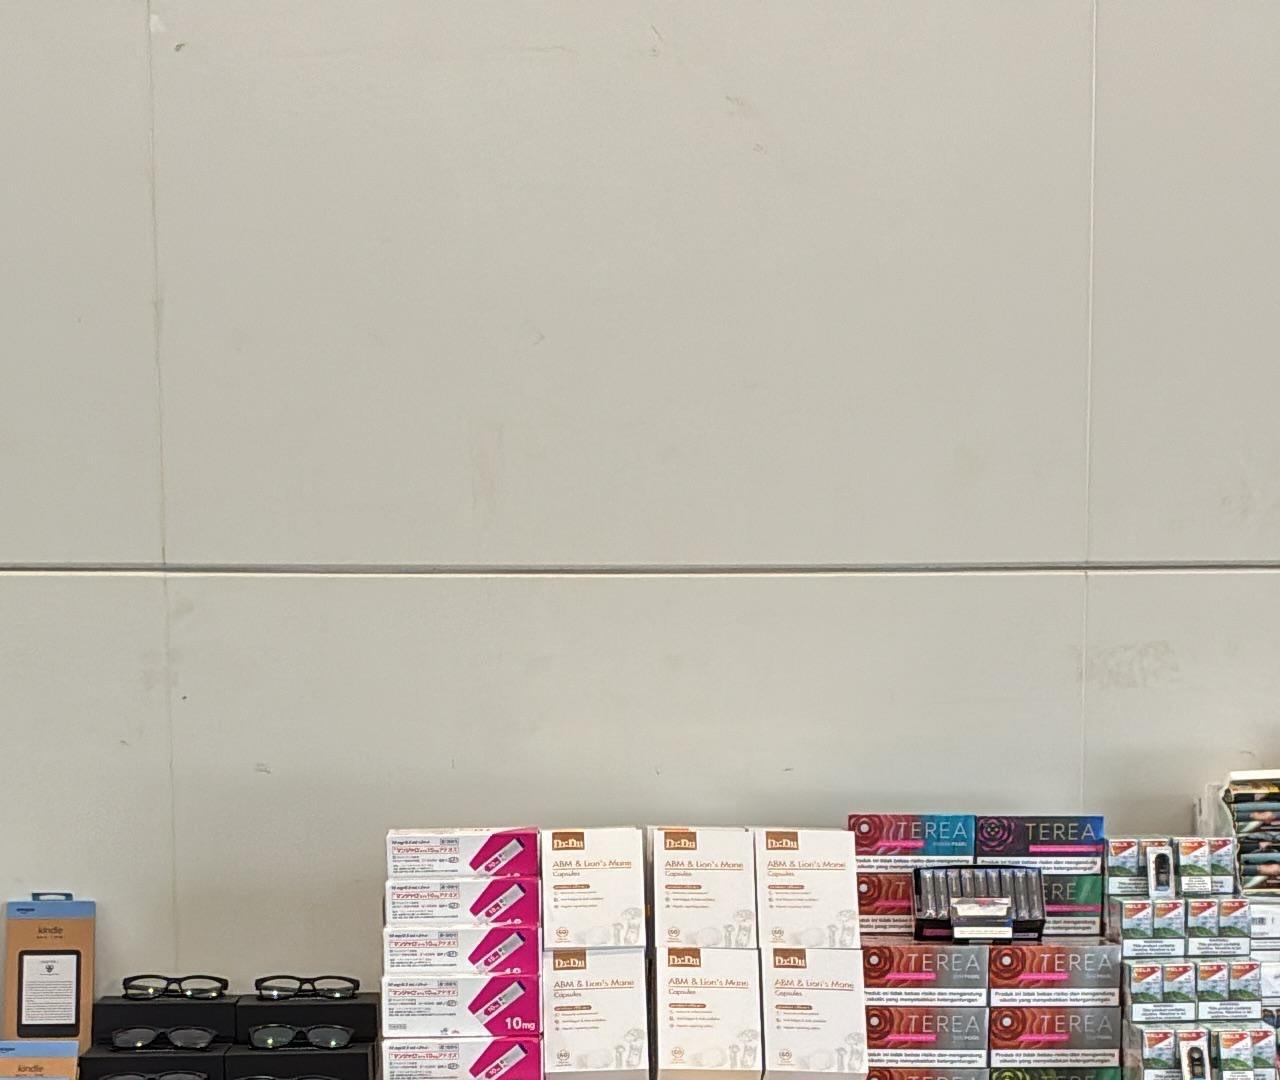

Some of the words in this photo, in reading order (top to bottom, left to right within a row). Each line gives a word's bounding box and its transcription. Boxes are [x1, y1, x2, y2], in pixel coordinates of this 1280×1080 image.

[897, 822, 967, 839] TEREA
[1025, 824, 1095, 840] TEREA
[38, 926, 63, 934] kindle
[908, 954, 980, 971] TEREA
[1040, 954, 1112, 971] TEREA
[506, 1017, 535, 1031] 10mg
[908, 1016, 980, 1032] TEREA
[1041, 1016, 1112, 1032] TEREA
[18, 1064, 44, 1072] kindle
